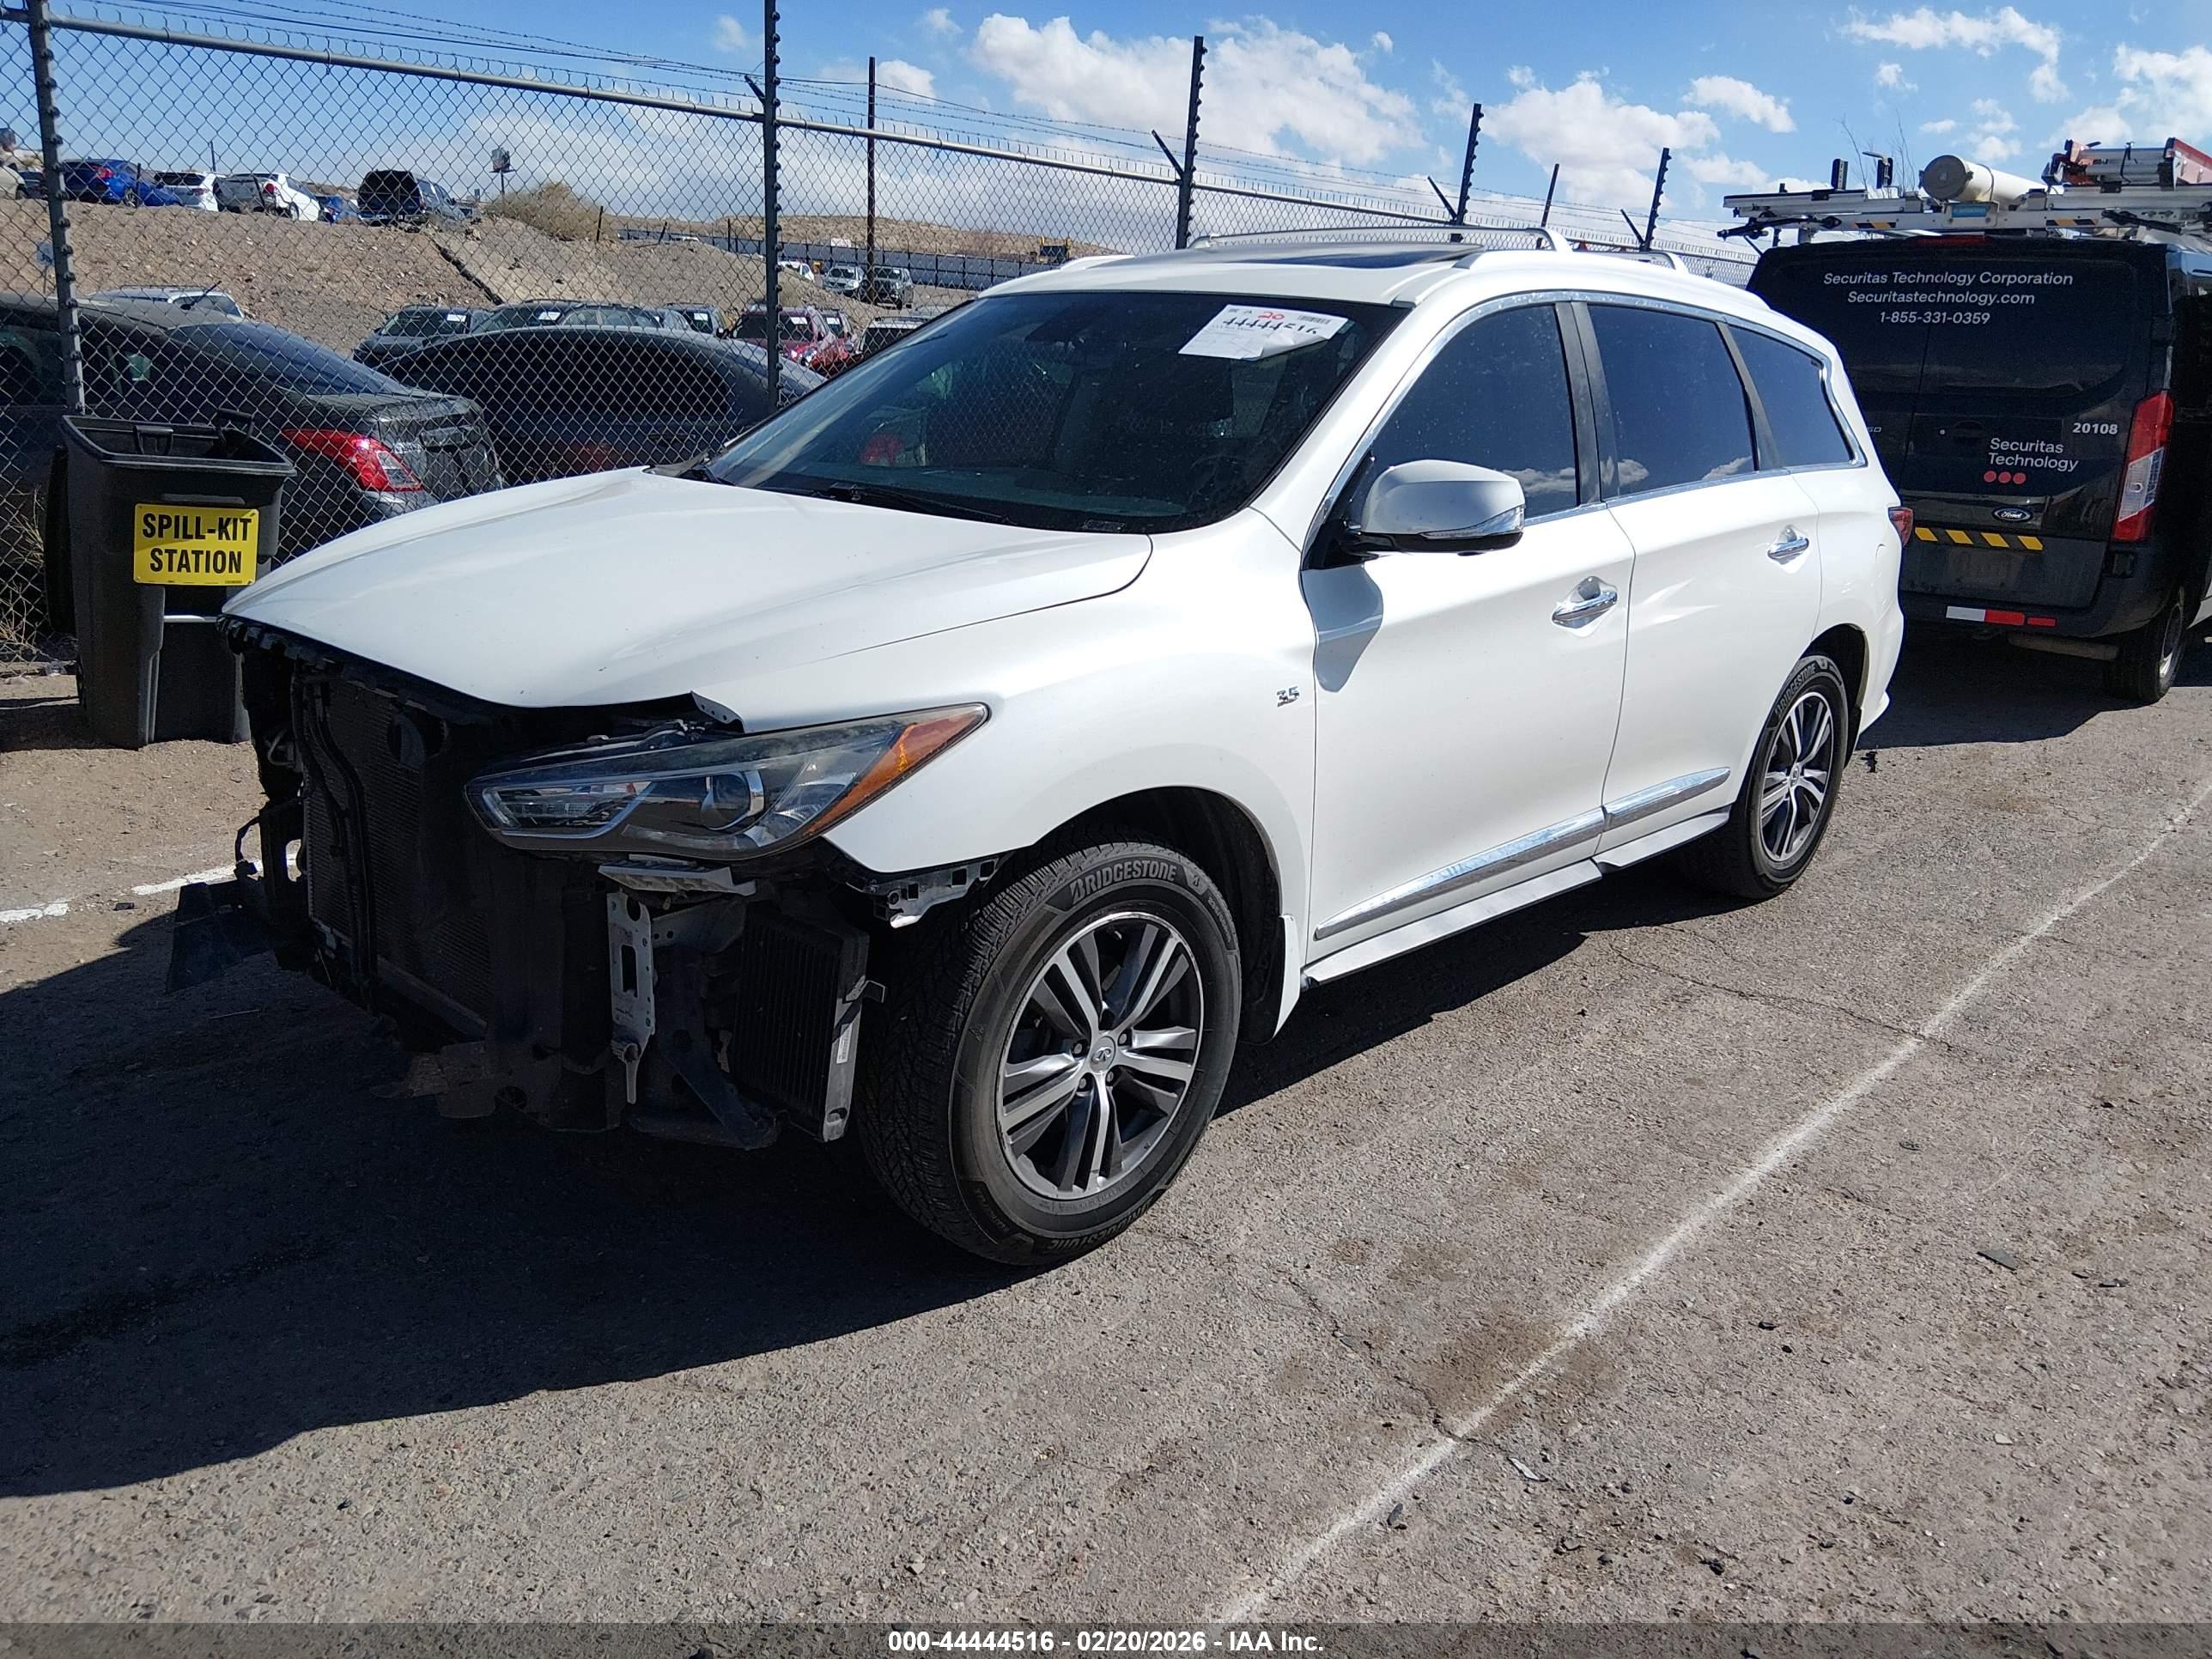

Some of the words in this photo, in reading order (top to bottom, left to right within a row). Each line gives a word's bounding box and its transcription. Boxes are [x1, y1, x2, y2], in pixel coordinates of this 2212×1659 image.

[1823, 272, 1887, 285] Securitas
[1892, 271, 1976, 286] Technology
[1979, 271, 2074, 286] Corporation
[1847, 290, 2035, 306] Securitastechnology.com
[1880, 311, 1990, 325] 1-855-331-0359
[2072, 422, 2118, 434] 20108
[1990, 437, 2064, 453] Securitas
[1988, 453, 2079, 472] Technology
[143, 513, 252, 541] SPILL-KIT
[149, 547, 242, 574] STATION
[1069, 860, 1177, 902] BRIDGESTONE
